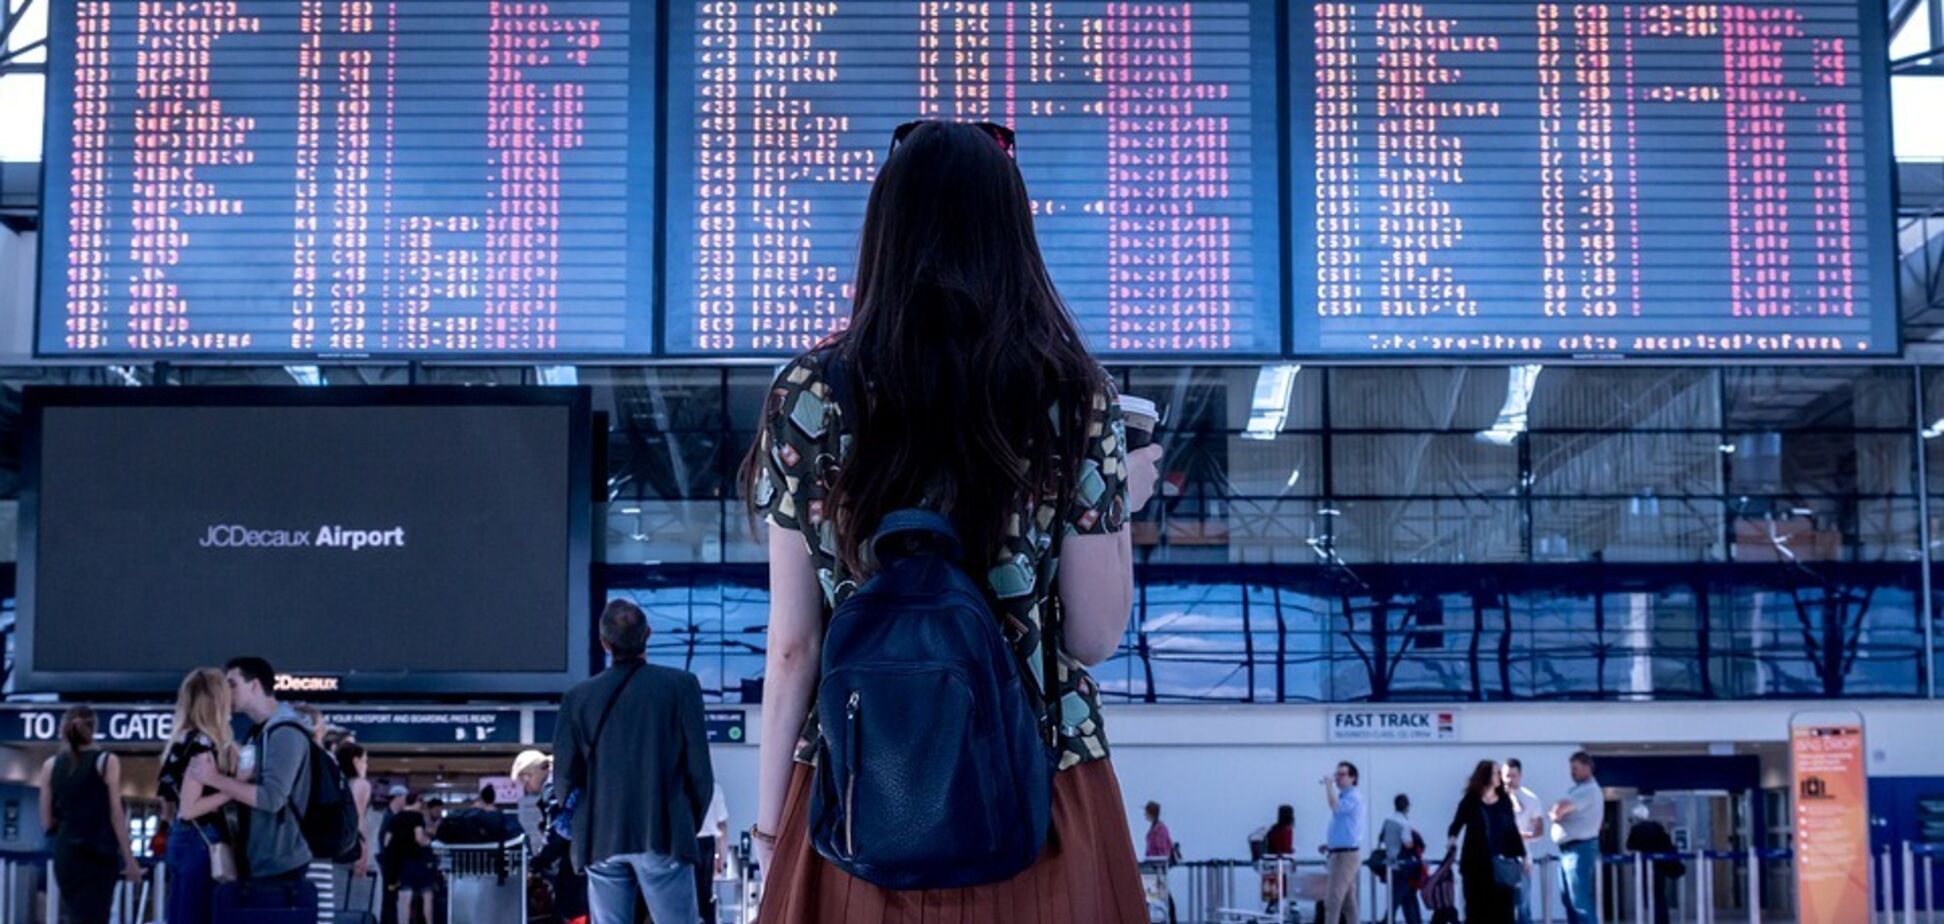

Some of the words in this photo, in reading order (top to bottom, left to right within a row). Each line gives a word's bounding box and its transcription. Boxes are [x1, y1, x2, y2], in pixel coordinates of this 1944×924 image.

[199, 525, 310, 547] JCDecaux
[315, 525, 404, 551] Airport
[19, 713, 55, 739] TO
[1336, 713, 1373, 728] FAST
[1378, 713, 1430, 728] TRACK
